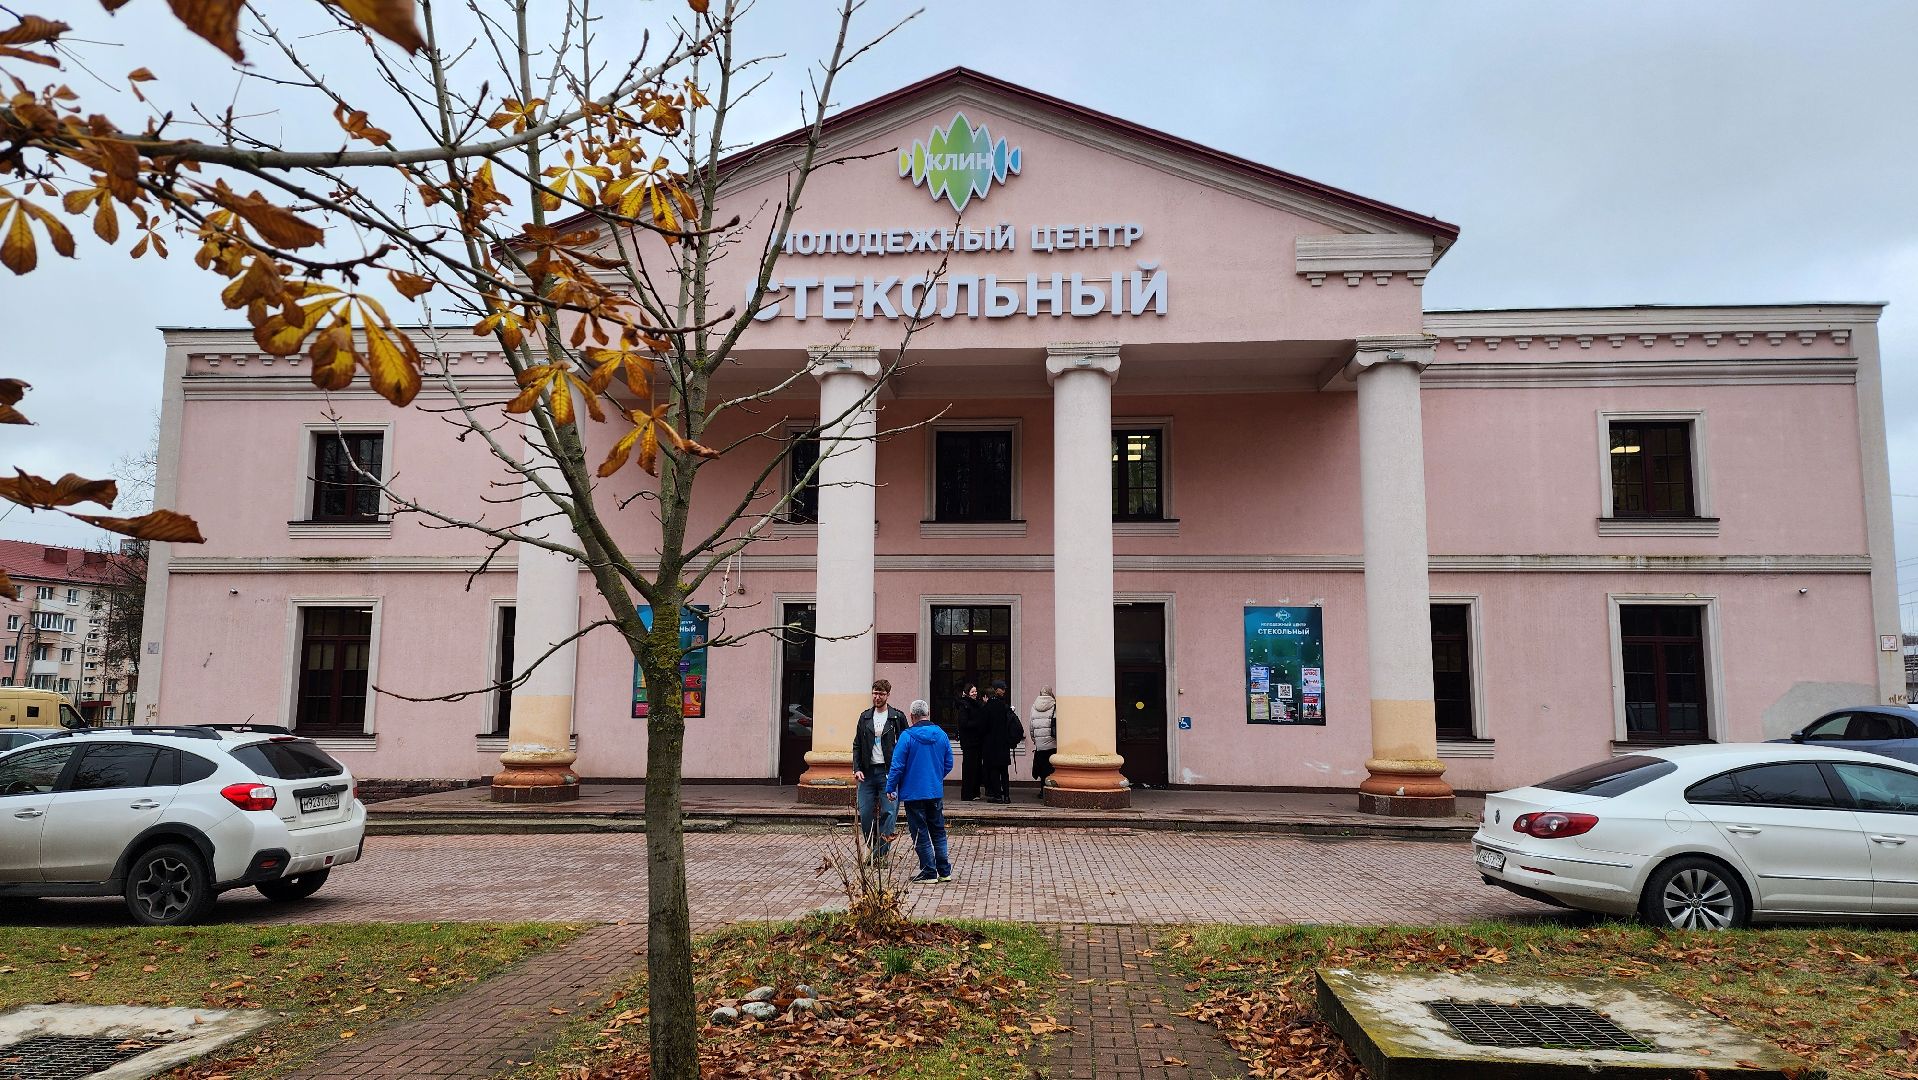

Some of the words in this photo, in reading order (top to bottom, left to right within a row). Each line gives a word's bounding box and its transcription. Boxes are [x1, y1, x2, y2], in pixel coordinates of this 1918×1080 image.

[926, 152, 993, 171] КЛИН
[1031, 223, 1144, 254] ЦЕНТР
[745, 259, 1168, 321] СТЕКОЛЬНЫЙ
[1257, 627, 1310, 635] СТЕКОЛЬНЫЙ
